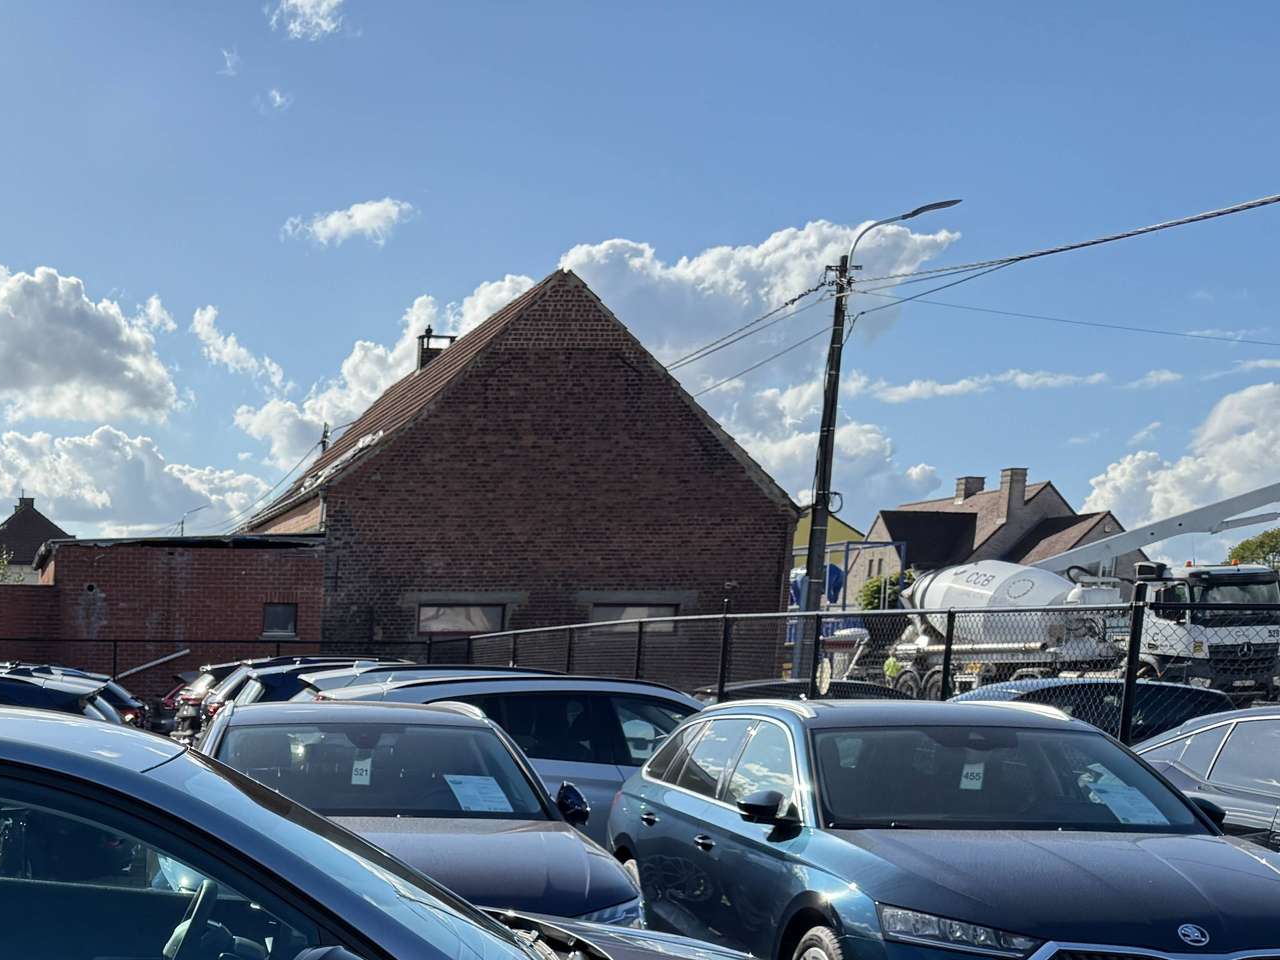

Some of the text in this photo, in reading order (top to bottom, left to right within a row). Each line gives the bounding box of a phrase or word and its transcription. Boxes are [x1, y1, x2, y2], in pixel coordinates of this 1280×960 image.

[966, 572, 996, 587] CCB
[353, 767, 369, 777] 521
[963, 771, 983, 781] 455
